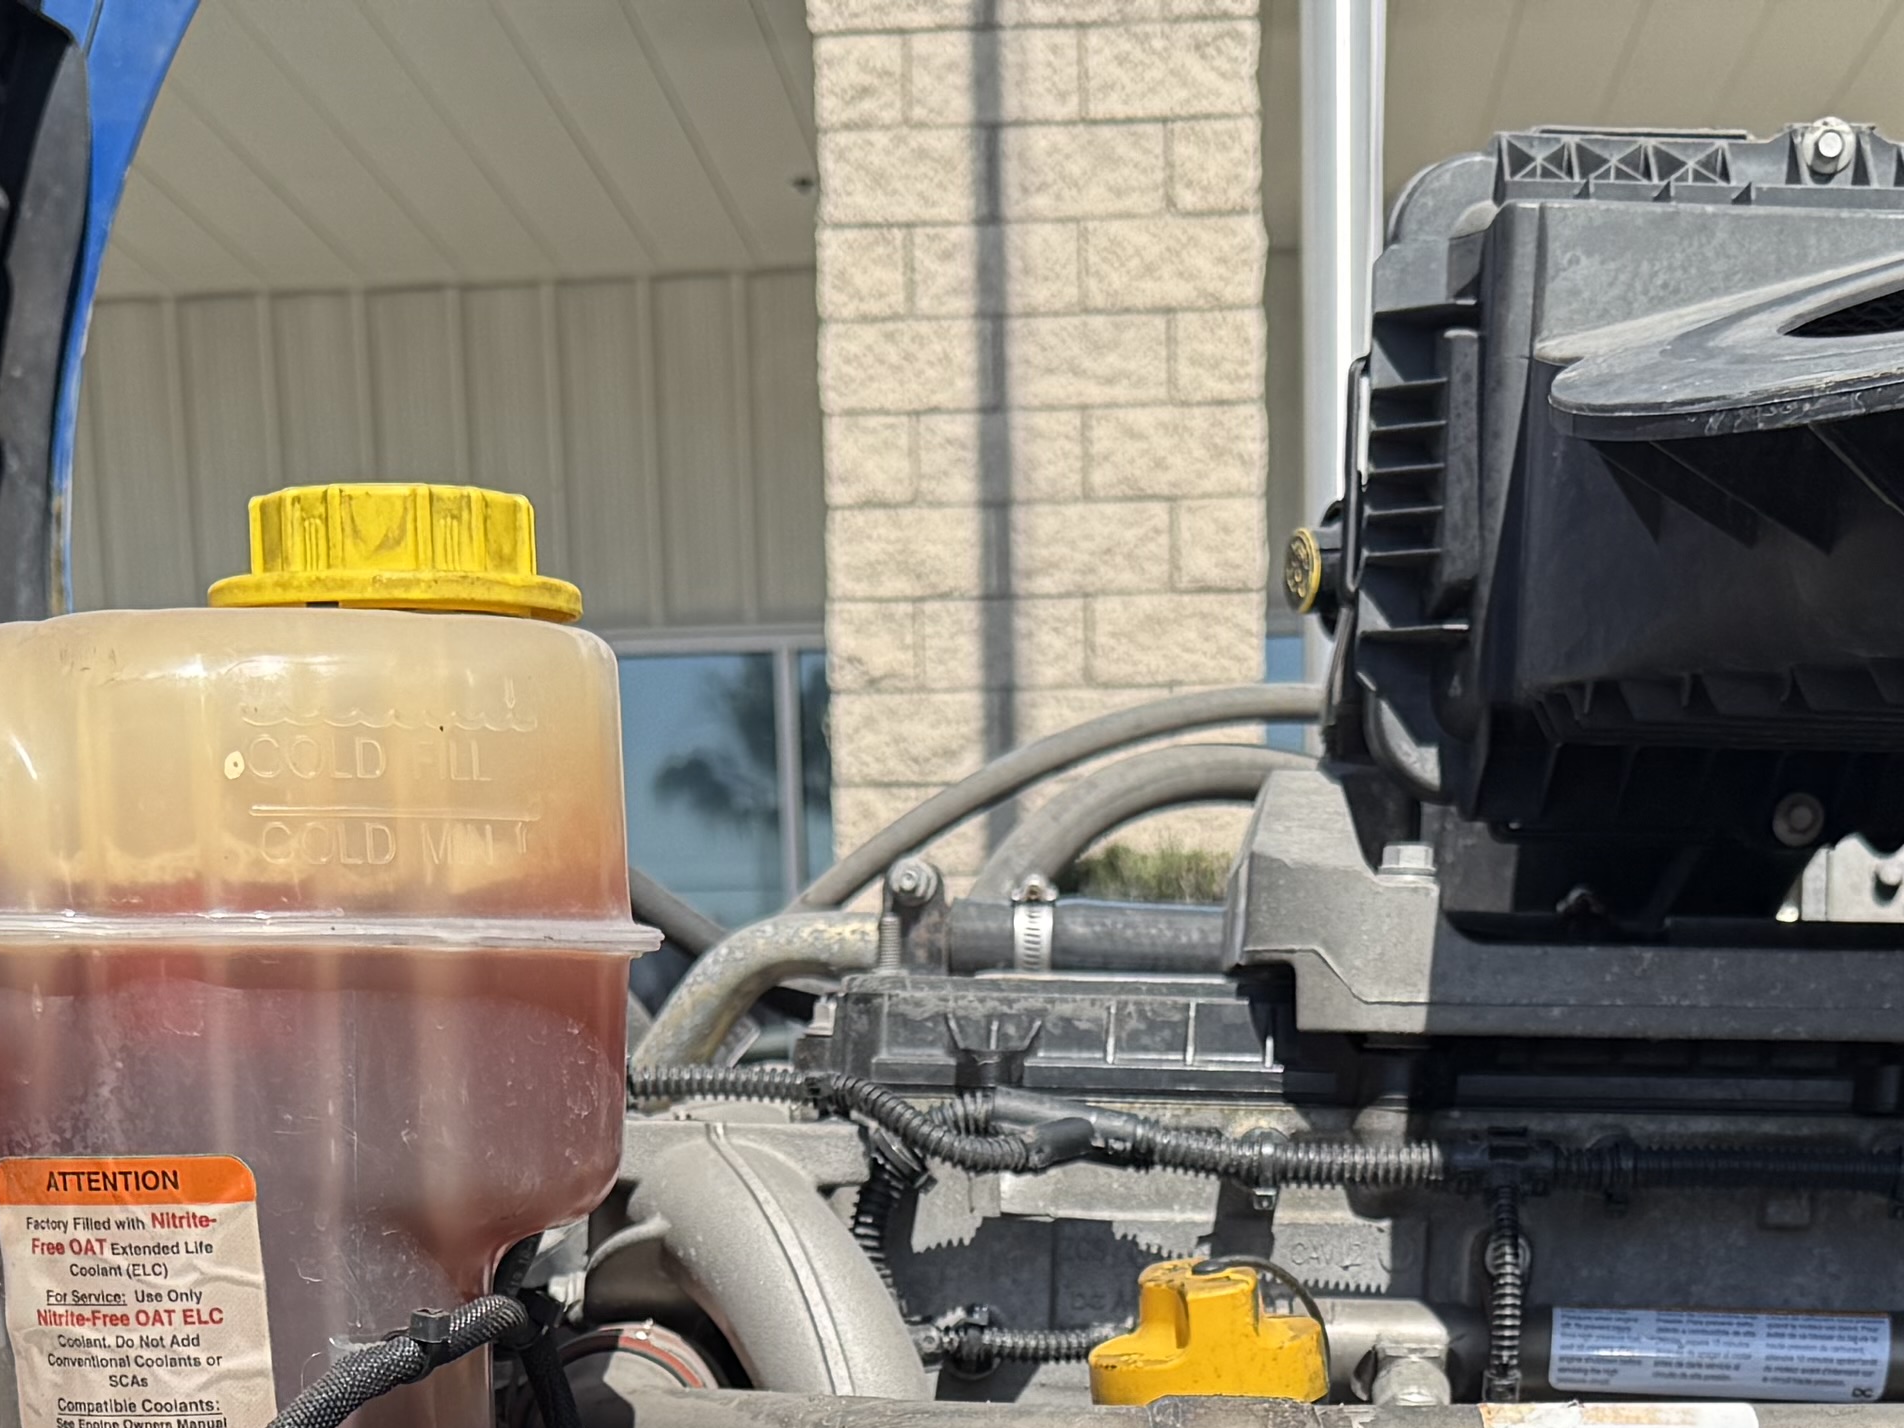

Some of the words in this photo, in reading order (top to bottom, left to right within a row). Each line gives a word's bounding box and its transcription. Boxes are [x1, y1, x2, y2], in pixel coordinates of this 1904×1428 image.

[247, 734, 385, 780] COLD
[414, 740, 493, 781] FILL
[261, 822, 396, 865] COLD
[421, 822, 494, 865] MIN
[46, 1170, 179, 1192] ATTENTION
[26, 1217, 69, 1233] Factory
[73, 1217, 111, 1231] Filled
[115, 1218, 145, 1231] with
[151, 1213, 217, 1229] Nitrite-
[32, 1239, 65, 1255] Free
[69, 1239, 107, 1255] OAT
[111, 1242, 180, 1256] Extended
[184, 1241, 213, 1255] Life
[70, 1265, 122, 1277] Coolant
[126, 1263, 169, 1279] (ELC)
[47, 1291, 69, 1303] For
[71, 1291, 127, 1304] Service:
[134, 1291, 163, 1303] Use
[167, 1289, 202, 1304] Only
[37, 1310, 130, 1326] Nitrite-Free
[135, 1310, 176, 1326] OAT
[182, 1308, 224, 1325] ELC
[58, 1335, 111, 1348] Coolant.
[115, 1335, 134, 1348] Do
[139, 1335, 165, 1348] Not
[170, 1334, 200, 1347] Add
[48, 1354, 130, 1368] Conventional
[134, 1356, 201, 1368] Coolants
[206, 1356, 223, 1366] or
[109, 1375, 148, 1388] SCAs
[1851, 1386, 1874, 1399] DC
[57, 1398, 136, 1414] Compatible
[141, 1398, 220, 1412] Coolants:
[177, 1418, 227, 1428] Manual
